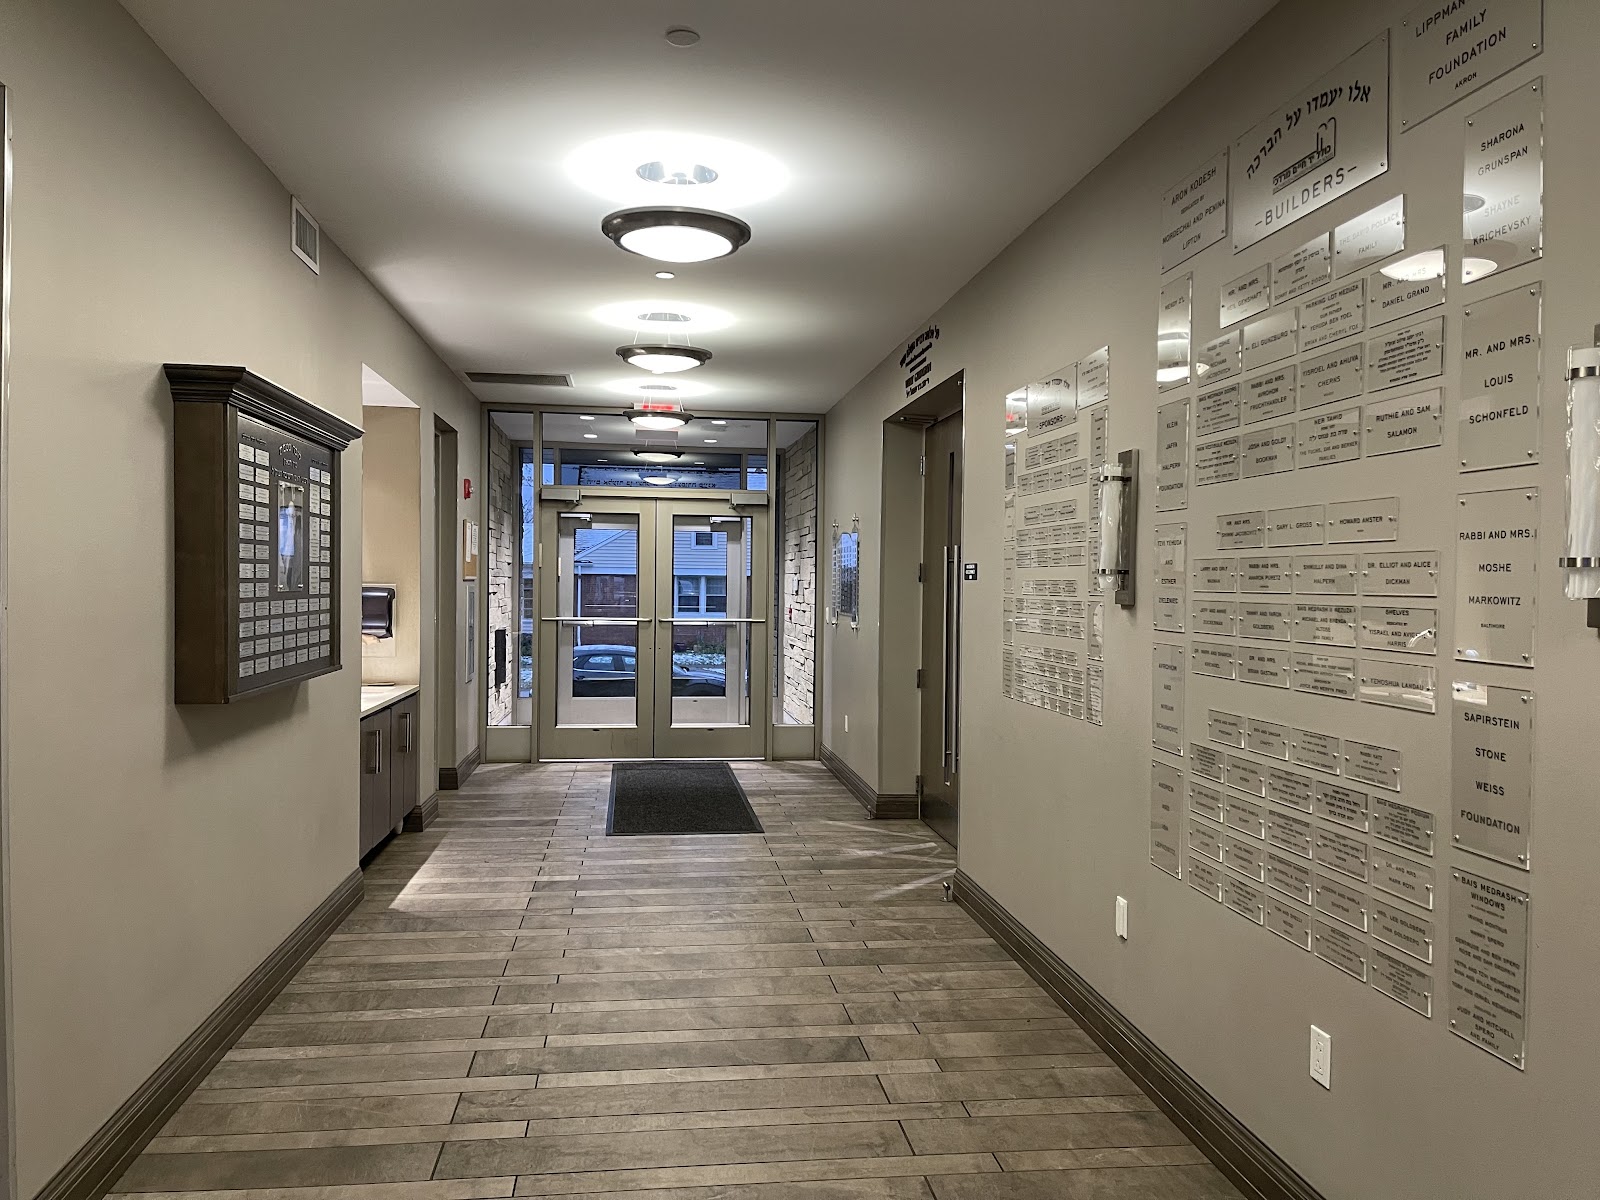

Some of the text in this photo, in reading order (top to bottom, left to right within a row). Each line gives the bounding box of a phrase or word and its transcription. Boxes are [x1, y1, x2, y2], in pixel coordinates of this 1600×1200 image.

[1446, 8, 1486, 45] FAMILY
[1428, 26, 1506, 84] FOUNDATION
[1454, 72, 1477, 90] AKRON
[1348, 80, 1371, 103] אלו
[1286, 107, 1302, 130] על
[1480, 122, 1524, 152] SHARONA
[1478, 146, 1528, 176] GRUNSPAN
[1171, 166, 1217, 206] ARON KODESH
[1484, 194, 1520, 218] SHAYNE
[1162, 220, 1192, 244] MORDECHAI
[1192, 212, 1204, 226] AND
[1473, 215, 1532, 246] KRICHEVSKY
[1182, 231, 1202, 250] LIPTON
[1358, 241, 1378, 254] FAMILY
[1382, 282, 1394, 290] MR.
[1382, 286, 1430, 309] DANIEL GRAND
[1318, 334, 1328, 342] AND
[1465, 334, 1535, 360] MR. AND MRS.
[1327, 361, 1338, 370] AND
[1340, 354, 1358, 365] AHUVA
[1484, 373, 1514, 388] LOUIS
[1376, 405, 1431, 422] RUTHIE AND SAM
[1469, 405, 1529, 424] SCHONFELD
[1387, 427, 1418, 439] SALAMON
[1459, 529, 1534, 540] RABBI AND MRS.
[1478, 563, 1512, 572] MOSHE
[1468, 595, 1521, 606] MARKOWITZ
[1370, 678, 1424, 691] YEHOSHUA LANDAU
[1464, 712, 1520, 730] SAPIRSTEIN
[1475, 747, 1507, 762] STONE
[1475, 780, 1505, 796] WEISS
[1460, 809, 1520, 835] FOUNDATION
[1402, 882, 1416, 891] ROTH
[1461, 876, 1517, 903] BAIS MEDRASH
[1470, 891, 1506, 912] WINDOWS
[1400, 919, 1426, 936] GOLDBERG
[1394, 930, 1420, 946] GOLDBERG
[1473, 954, 1482, 963] AND
[1480, 948, 1490, 957] AND
[1503, 957, 1520, 970] SPERO
[1468, 965, 1477, 974] AND
[1464, 986, 1474, 996] AND
[1473, 1012, 1485, 1023] AND
[1486, 1018, 1514, 1040] MITCHELL
[1475, 1024, 1495, 1039] SPERO
[1470, 1031, 1499, 1051] AND FAMILY
